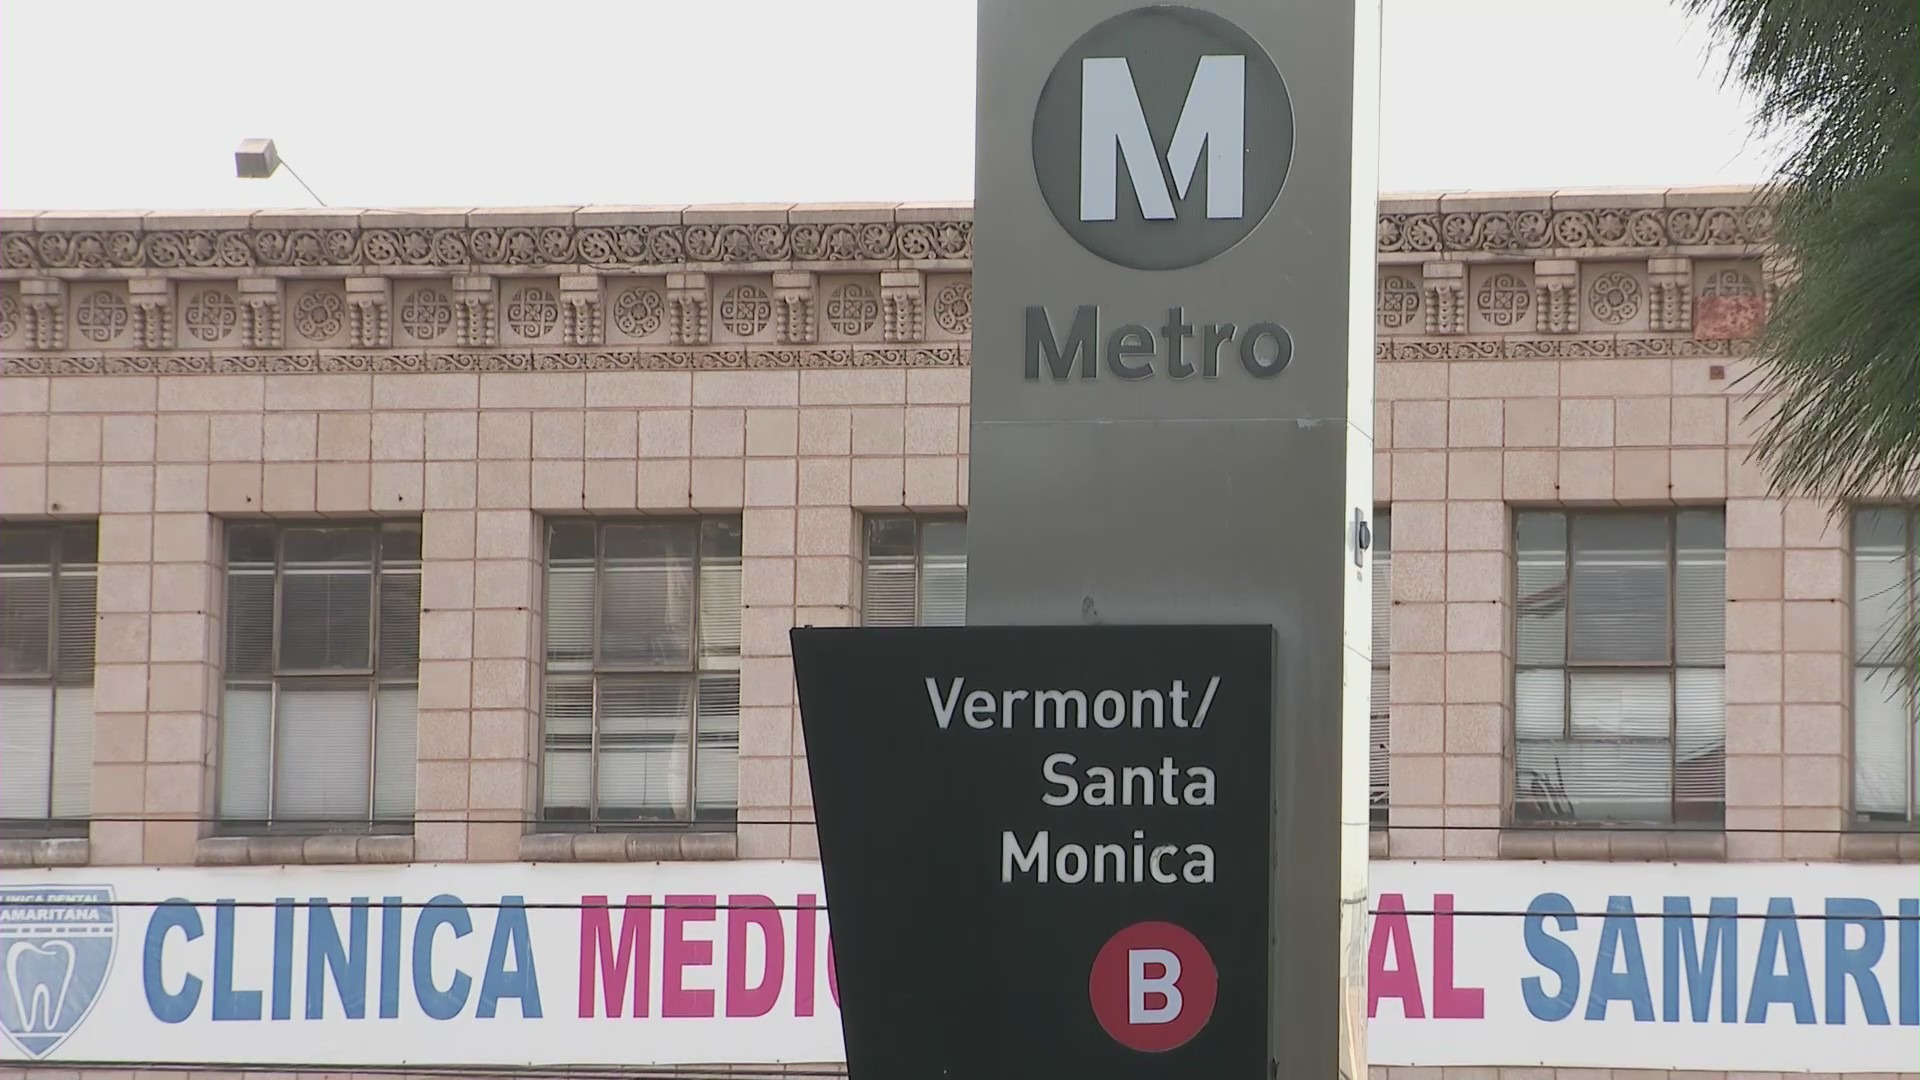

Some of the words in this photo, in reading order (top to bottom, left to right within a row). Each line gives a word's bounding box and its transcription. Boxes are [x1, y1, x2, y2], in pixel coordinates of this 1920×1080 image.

[1080, 54, 1246, 222] M
[1024, 304, 1294, 381] Metro
[924, 675, 1221, 730] Vermont/
[1041, 752, 1217, 807] Santa
[1001, 829, 1216, 884] Monica
[143, 894, 543, 1023] CLINICA
[578, 893, 842, 1019] MEDI
[1520, 892, 1920, 1026] SAMARI
[1127, 947, 1184, 1025] B
